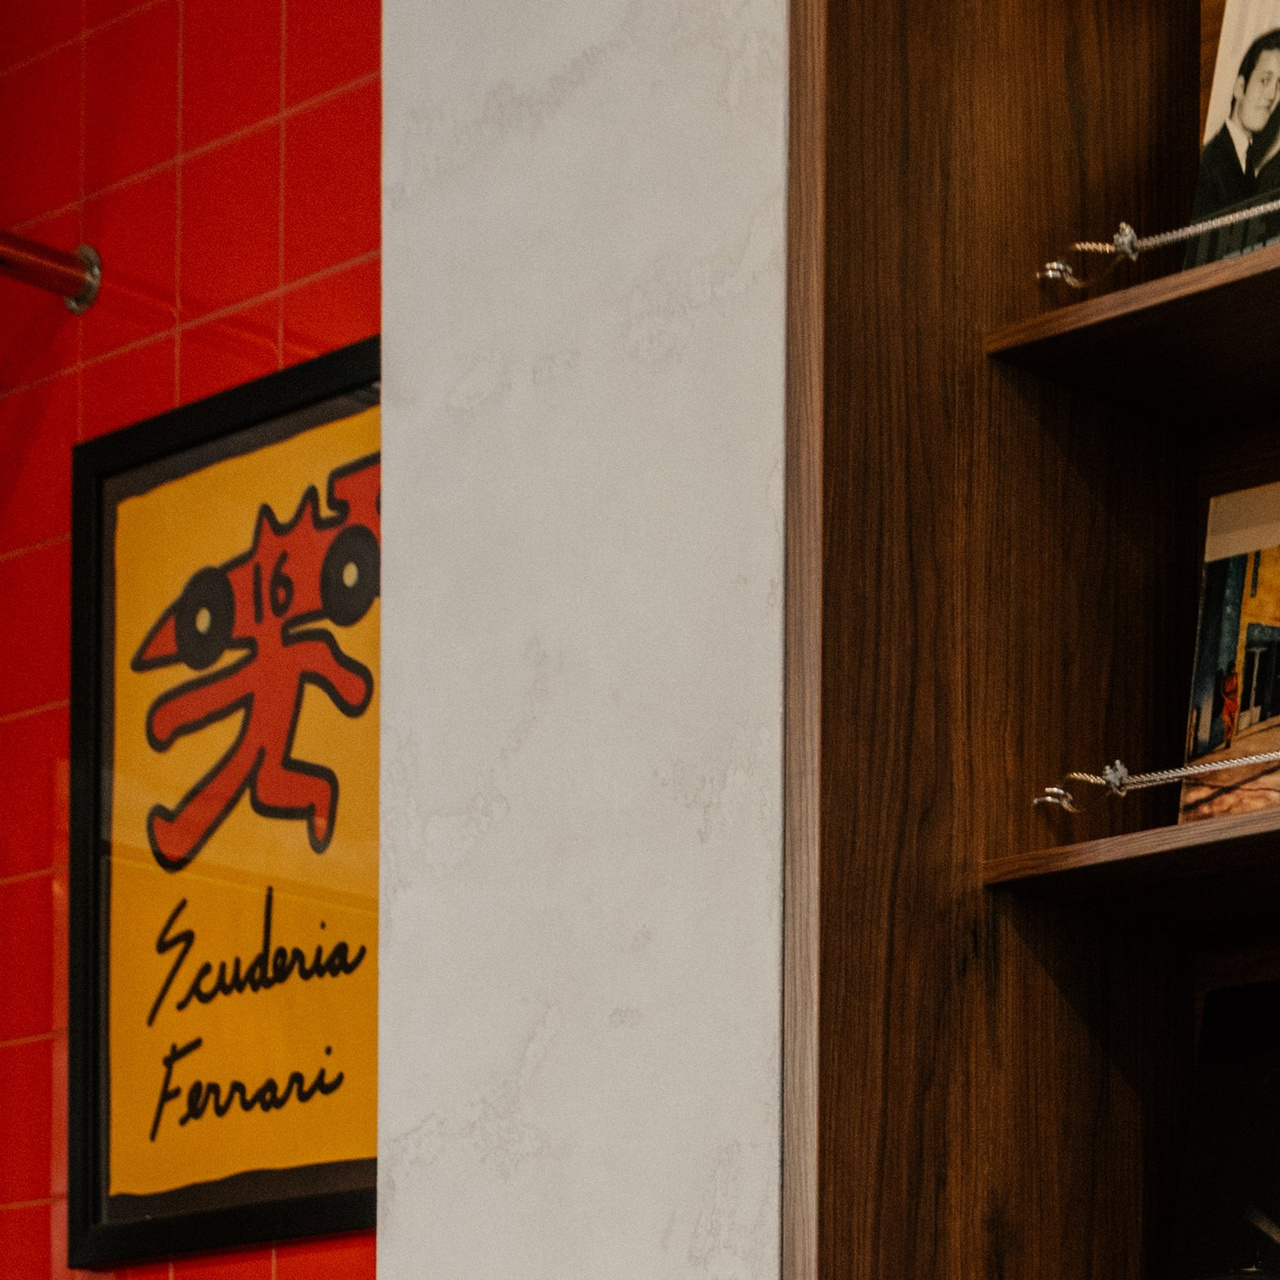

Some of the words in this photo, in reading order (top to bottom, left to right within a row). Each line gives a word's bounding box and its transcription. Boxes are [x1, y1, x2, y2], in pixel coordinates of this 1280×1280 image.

[254, 550, 295, 624] 16
[147, 886, 366, 1027] Scuderia
[148, 1038, 344, 1142] Ferrari
